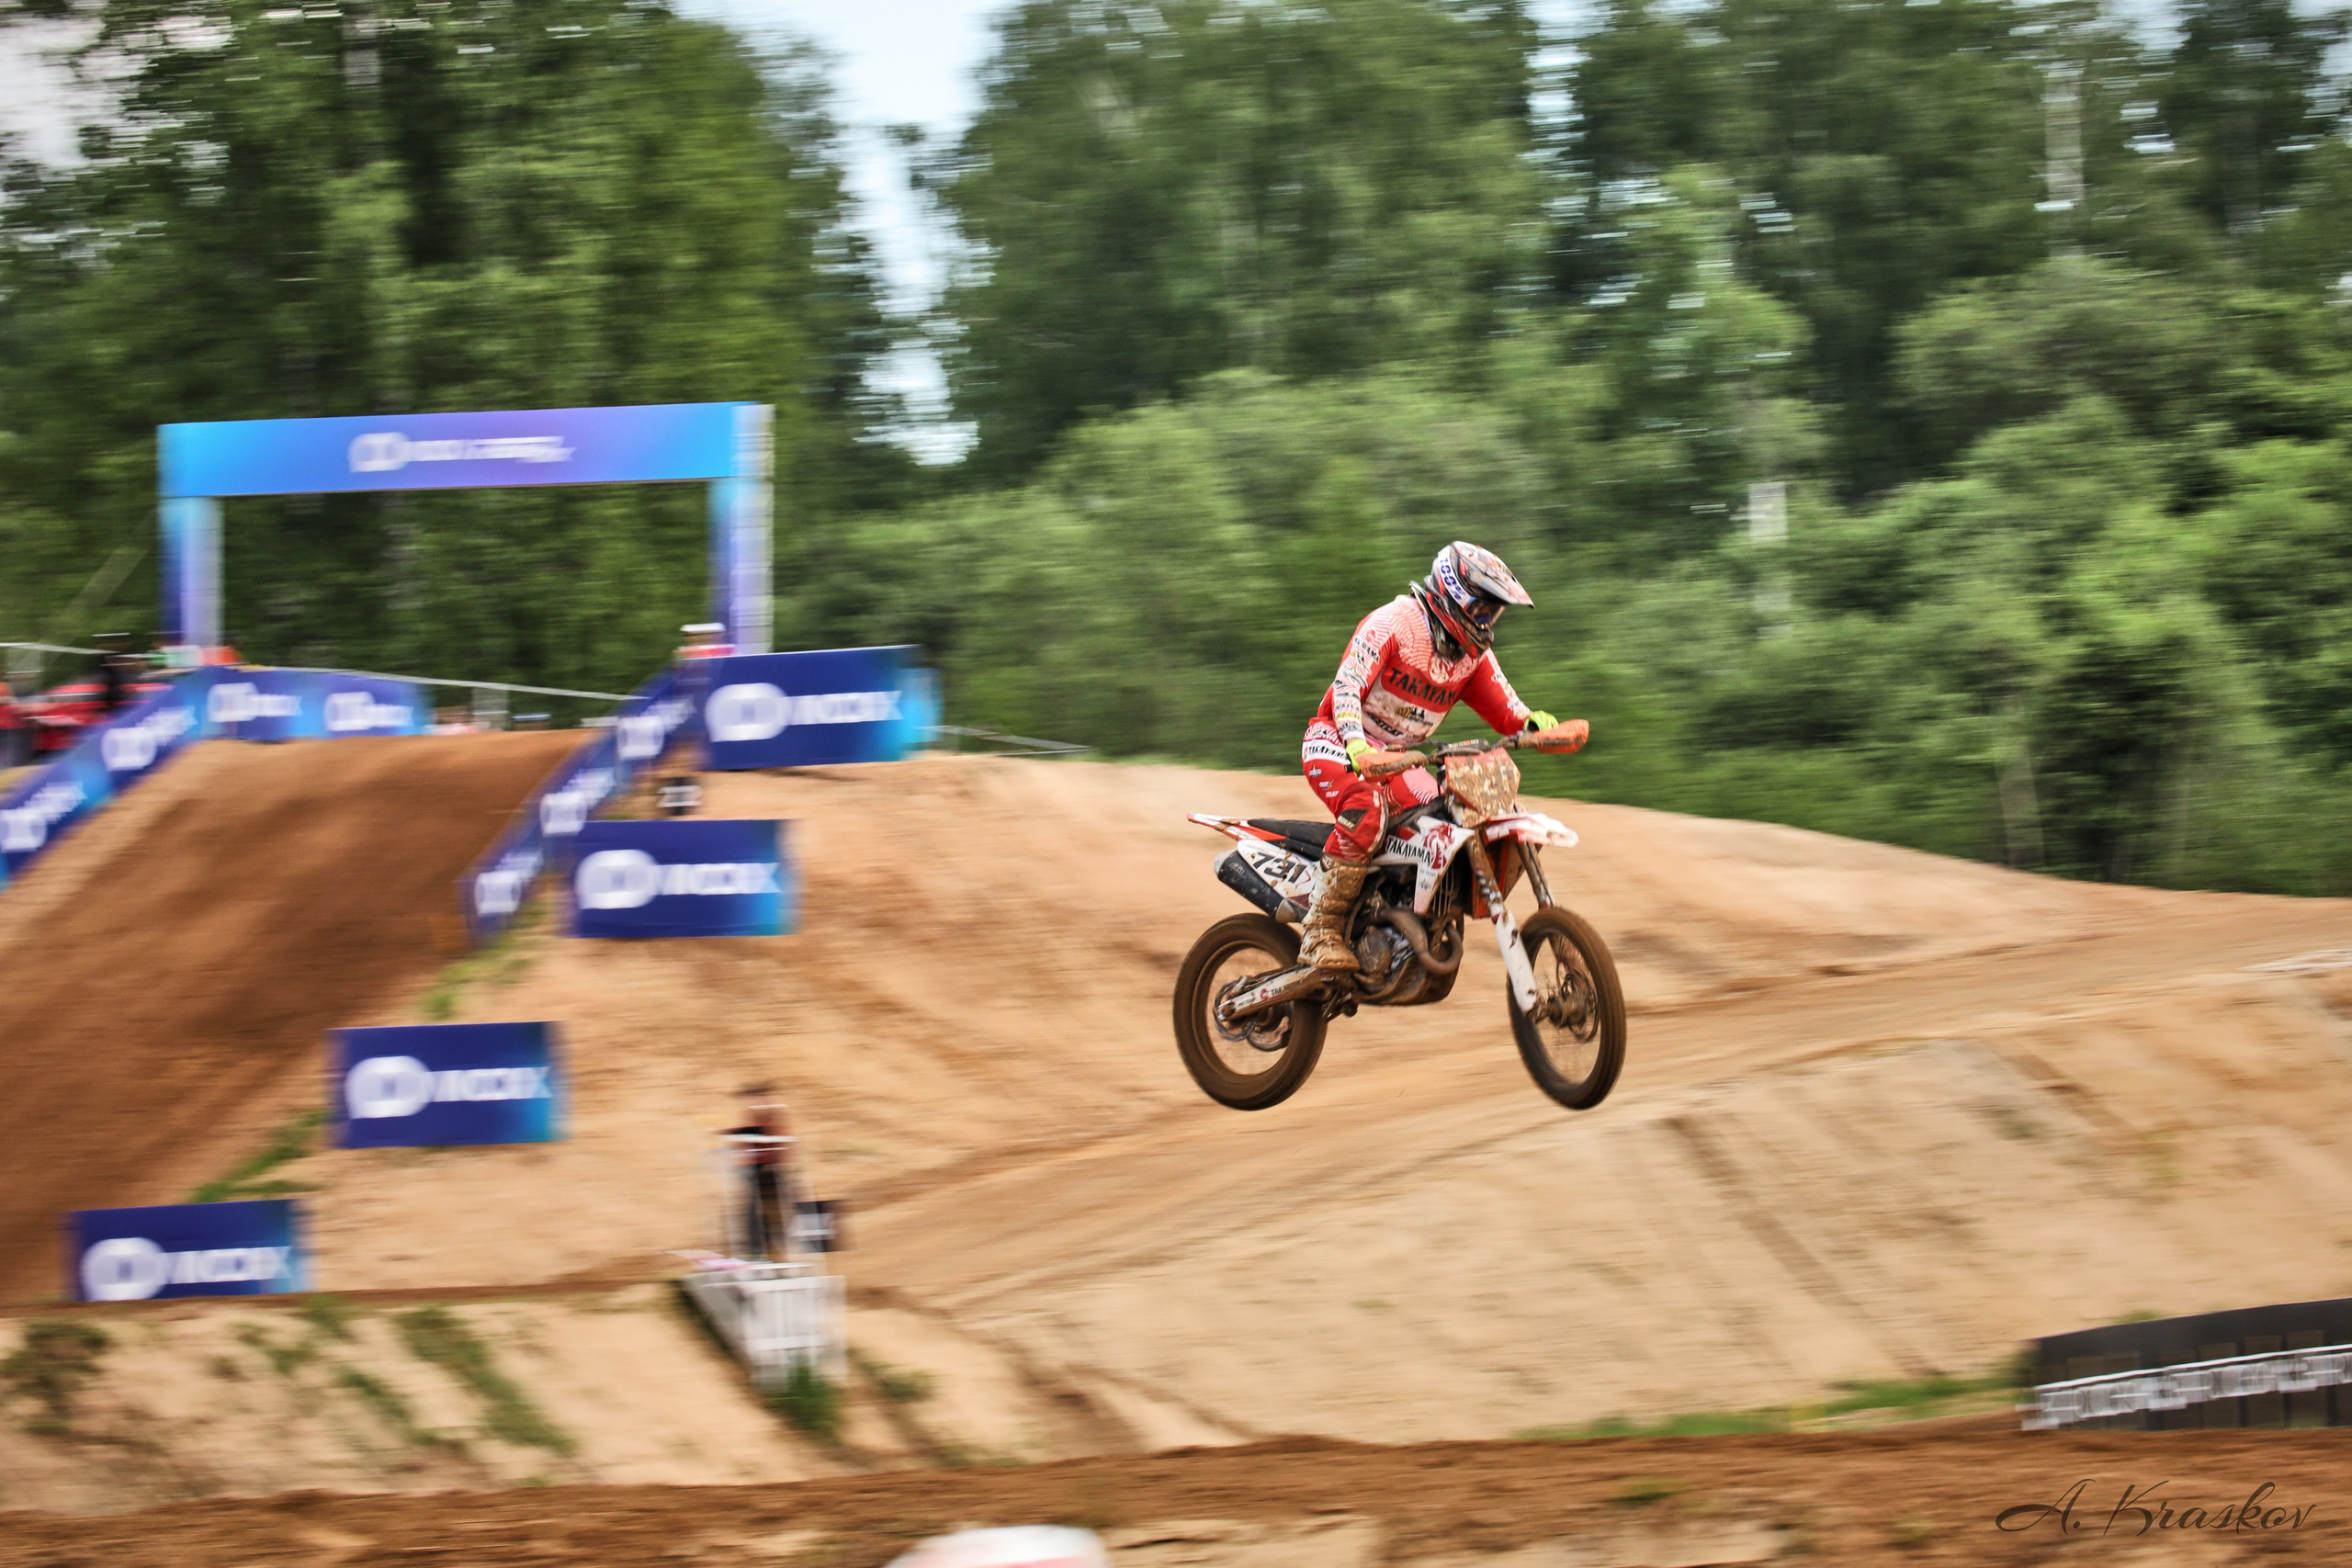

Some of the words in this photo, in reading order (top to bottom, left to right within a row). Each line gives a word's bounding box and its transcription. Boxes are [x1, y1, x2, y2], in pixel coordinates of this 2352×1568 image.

[1388, 668, 1457, 705] TAKAYAM
[1308, 745, 1347, 761] TAKAYAM
[1385, 837, 1431, 865] TAKAYAMA
[1252, 852, 1307, 884] 731
